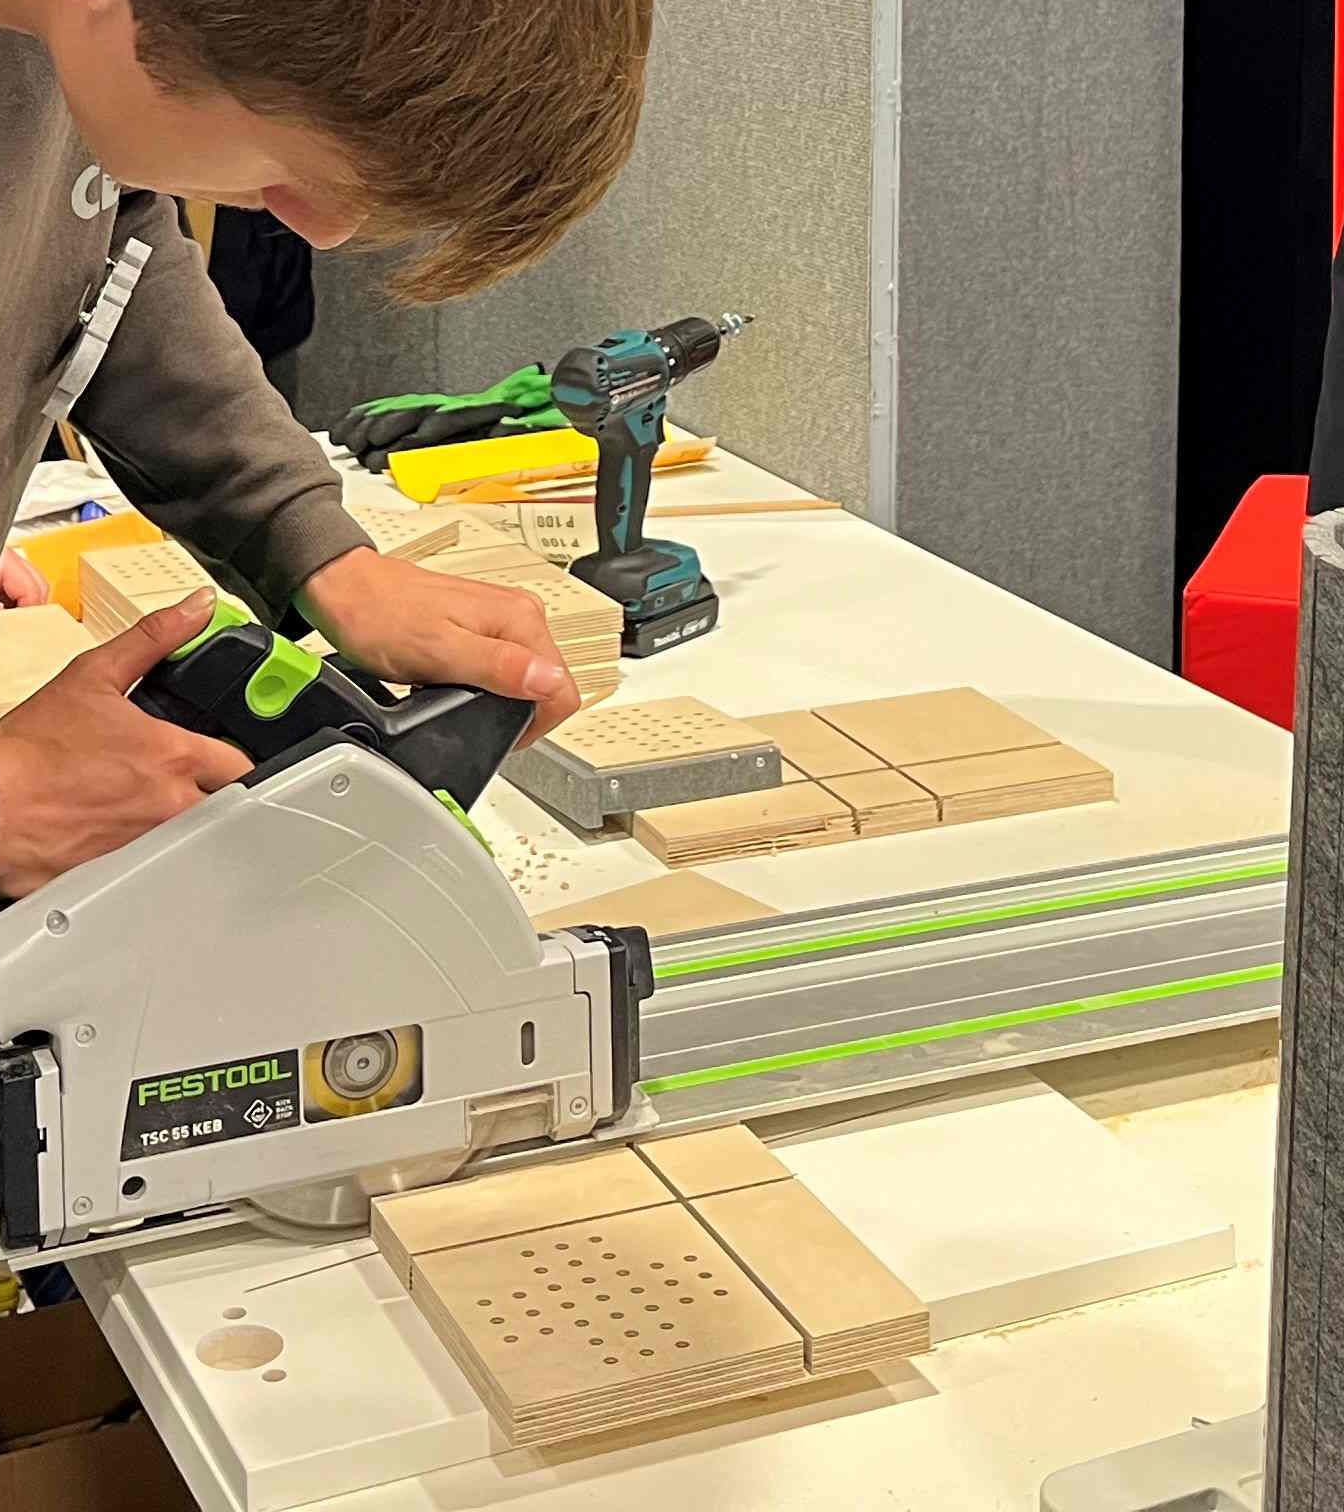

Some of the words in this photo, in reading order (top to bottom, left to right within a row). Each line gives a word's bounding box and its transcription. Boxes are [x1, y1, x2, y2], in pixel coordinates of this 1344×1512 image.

[137, 1058, 293, 1107] FESTOOL
[140, 1130, 170, 1147] TSC
[171, 1124, 191, 1141] 55
[192, 1118, 224, 1137] KEB
